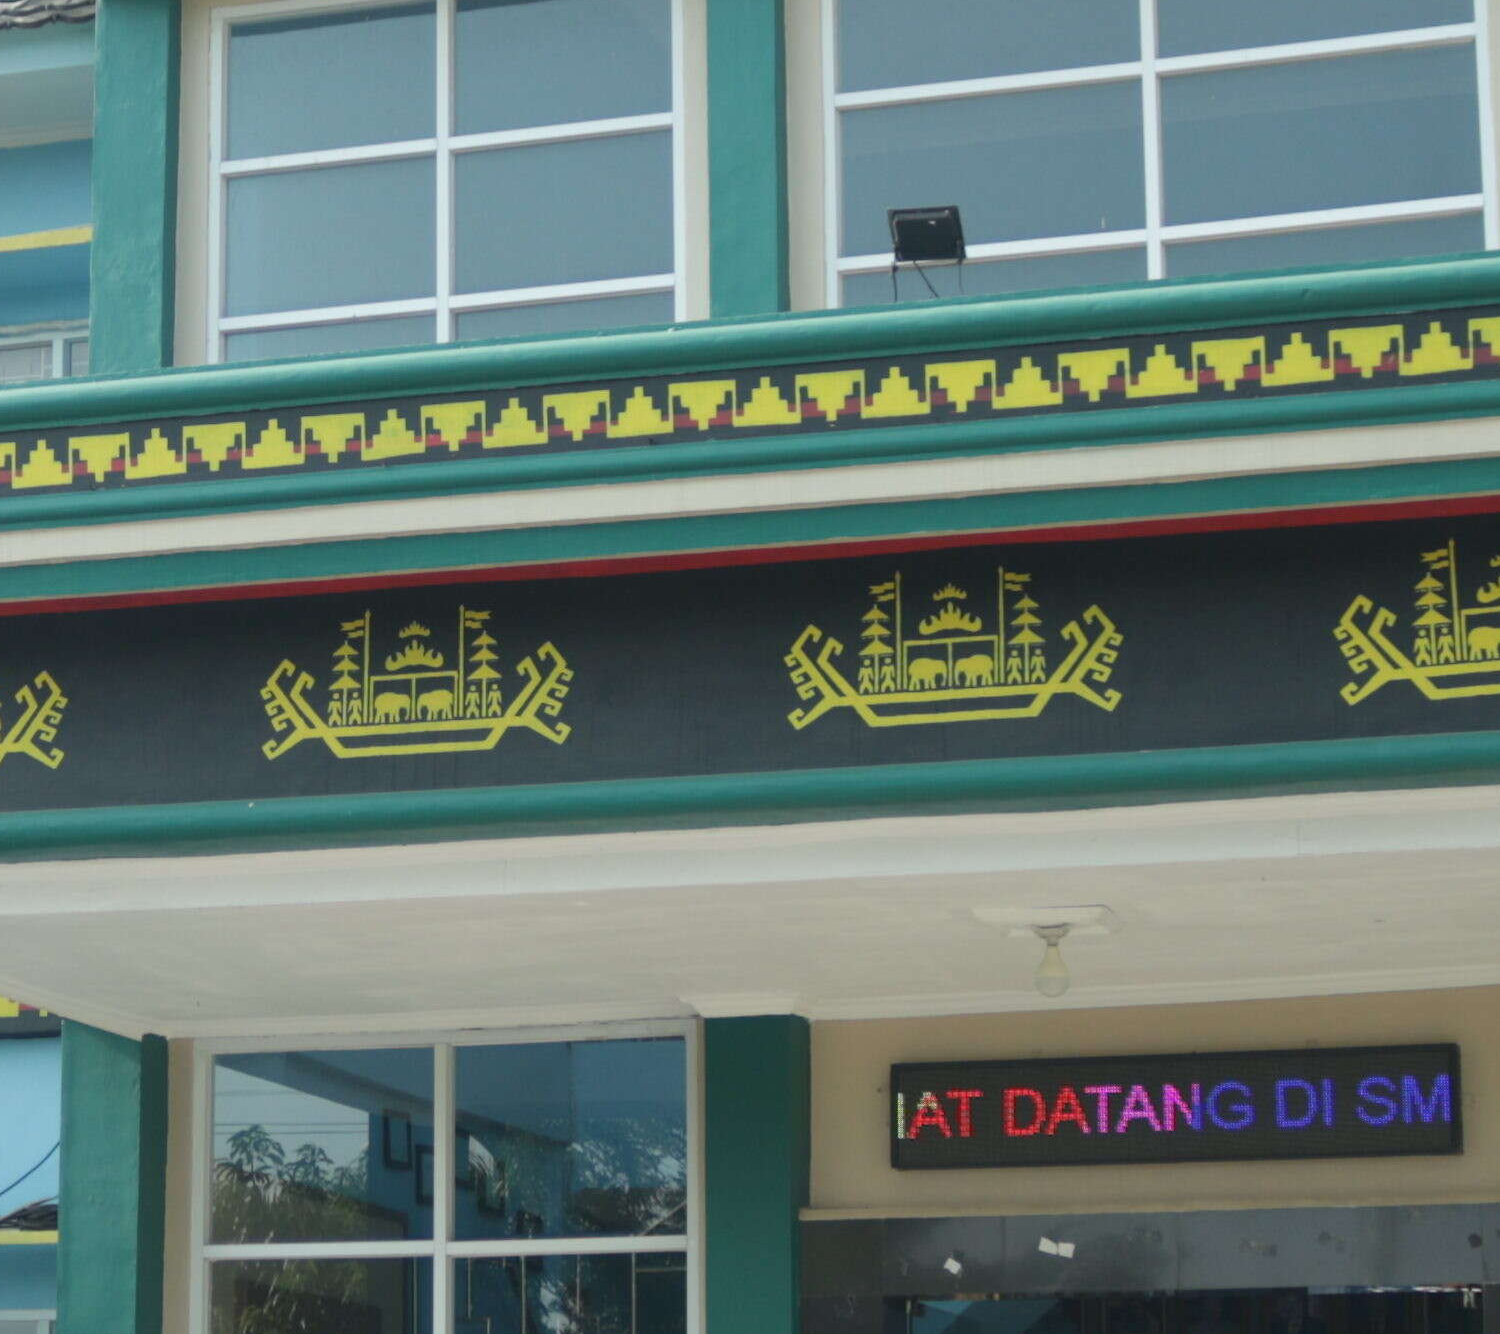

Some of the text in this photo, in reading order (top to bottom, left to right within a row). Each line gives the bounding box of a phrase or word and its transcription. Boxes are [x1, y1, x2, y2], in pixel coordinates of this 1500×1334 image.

[1002, 1081, 1256, 1138] DATANG
[1275, 1077, 1334, 1129] DI
[1356, 1073, 1453, 1126] SM
